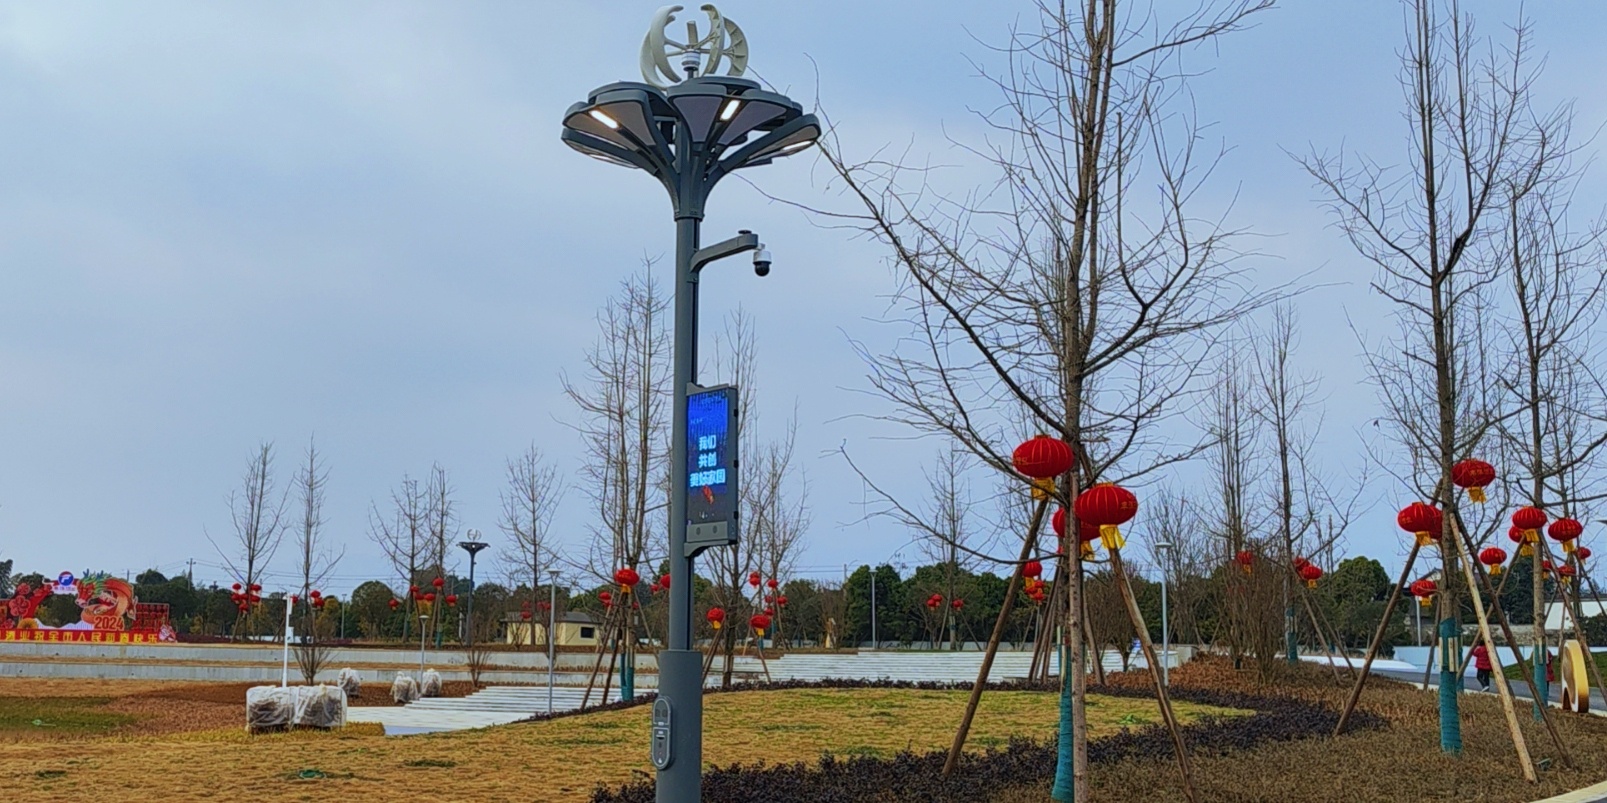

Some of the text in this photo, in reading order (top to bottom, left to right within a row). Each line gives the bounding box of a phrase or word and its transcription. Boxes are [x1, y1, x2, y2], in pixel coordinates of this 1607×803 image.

[698, 434, 717, 451] 我们
[698, 452, 717, 468] 共创
[94, 616, 124, 630] 2024
[0, 630, 158, 644] 酒业祝全市人民新春快乐
